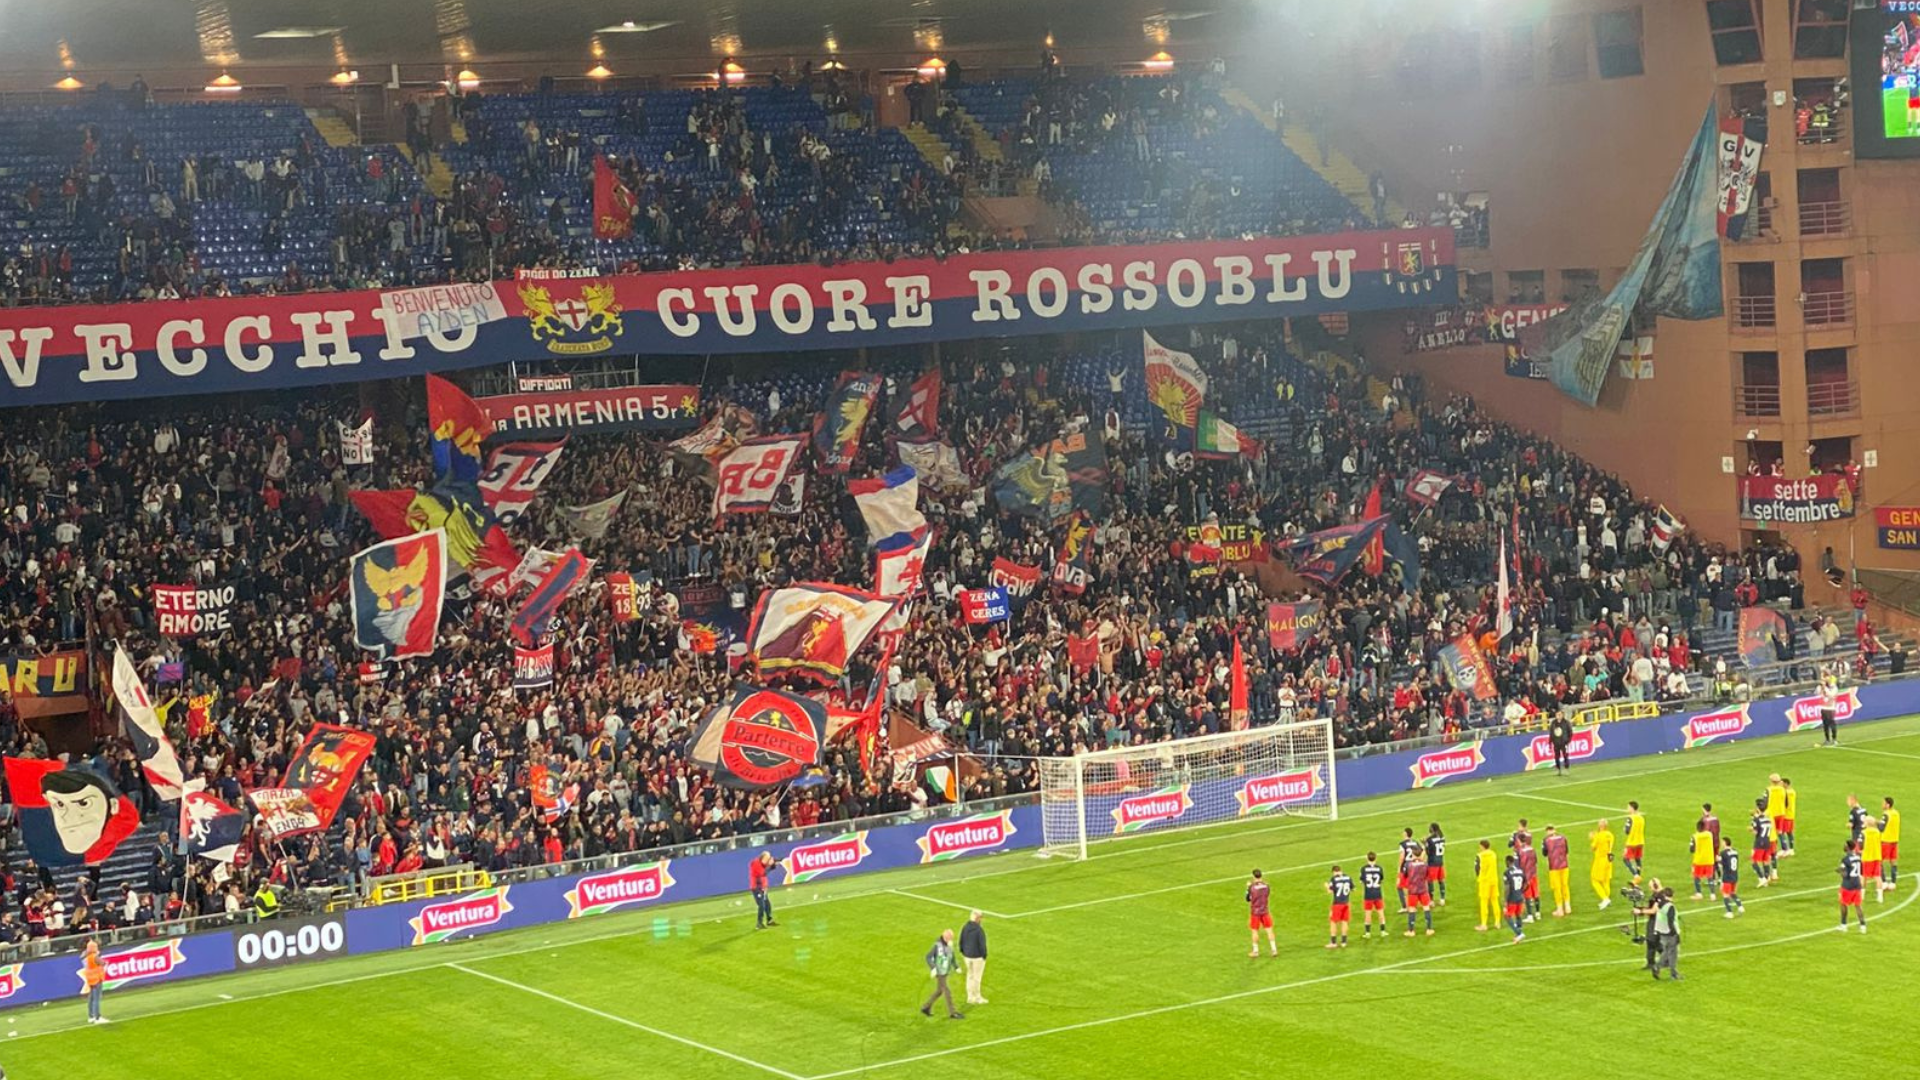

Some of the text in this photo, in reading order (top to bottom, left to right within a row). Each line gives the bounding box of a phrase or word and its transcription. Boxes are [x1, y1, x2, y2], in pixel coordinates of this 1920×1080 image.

[569, 266, 600, 278] ZENA
[392, 283, 493, 313] BENVENUTO
[657, 275, 933, 337] CUORE
[969, 249, 1356, 322] ROSSOBLU
[418, 304, 489, 334] AYDEN
[1501, 307, 1566, 338] GEN
[520, 378, 571, 391] DIFFIDATI
[513, 397, 643, 429] ARMENIA
[1774, 480, 1817, 500] sette
[1753, 500, 1840, 522] settembre
[1887, 530, 1916, 544] SAN
[155, 586, 235, 611] ETERNO
[969, 591, 1000, 602] ZENA
[160, 609, 231, 634] AMORE
[971, 605, 1005, 618] CERES
[1798, 700, 1848, 718] Venra
[1693, 718, 1740, 733] Ventura
[734, 725, 805, 754] Parterre
[1536, 738, 1588, 756] Veura
[1423, 756, 1472, 773] Ventura
[1251, 780, 1309, 801] Ventura
[1125, 801, 1178, 817] Ventura
[934, 828, 999, 849] Ventura
[796, 847, 856, 868] Ventura
[583, 878, 656, 902] Ventura
[427, 903, 495, 928] Ventura
[237, 921, 344, 964] 00:00
